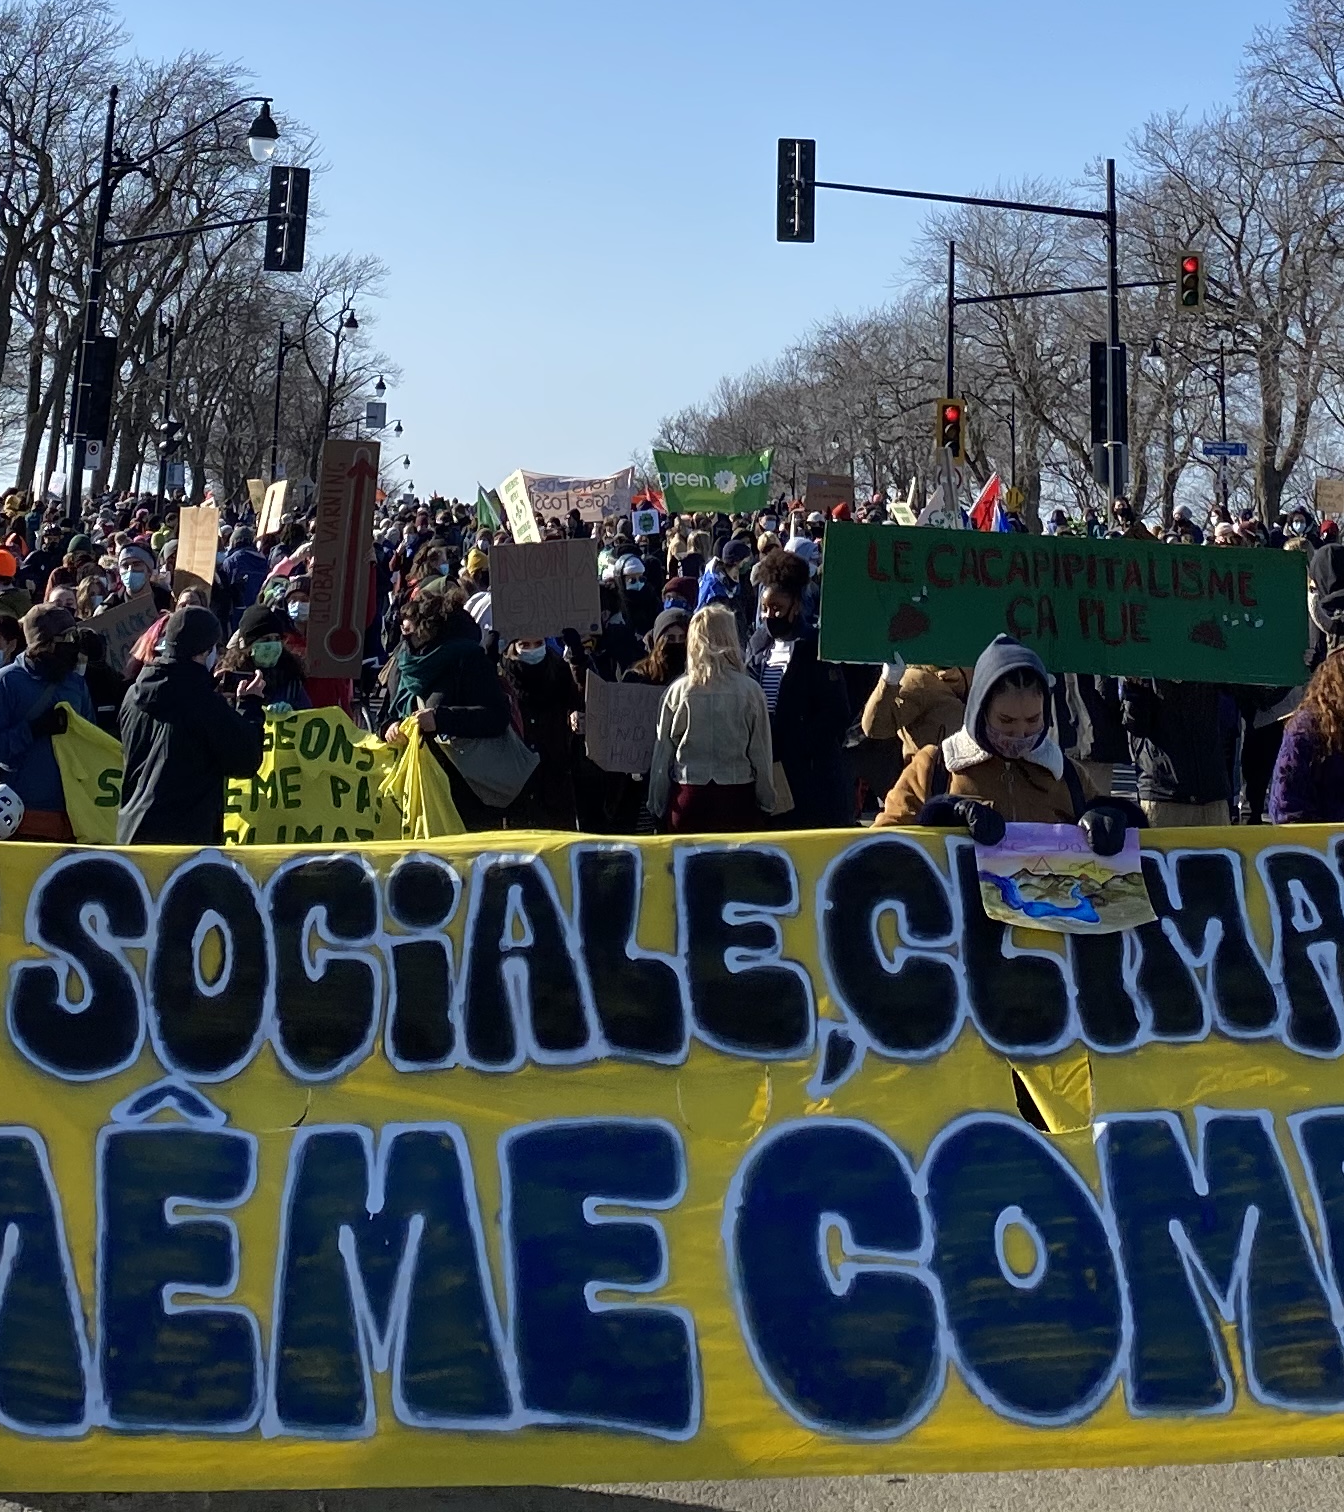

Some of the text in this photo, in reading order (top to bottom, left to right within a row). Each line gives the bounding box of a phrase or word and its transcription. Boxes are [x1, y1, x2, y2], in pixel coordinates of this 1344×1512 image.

[659, 472, 711, 489] green
[867, 538, 916, 583] LE
[311, 557, 336, 625] GLOBAL
[1077, 596, 1152, 647] PUE
